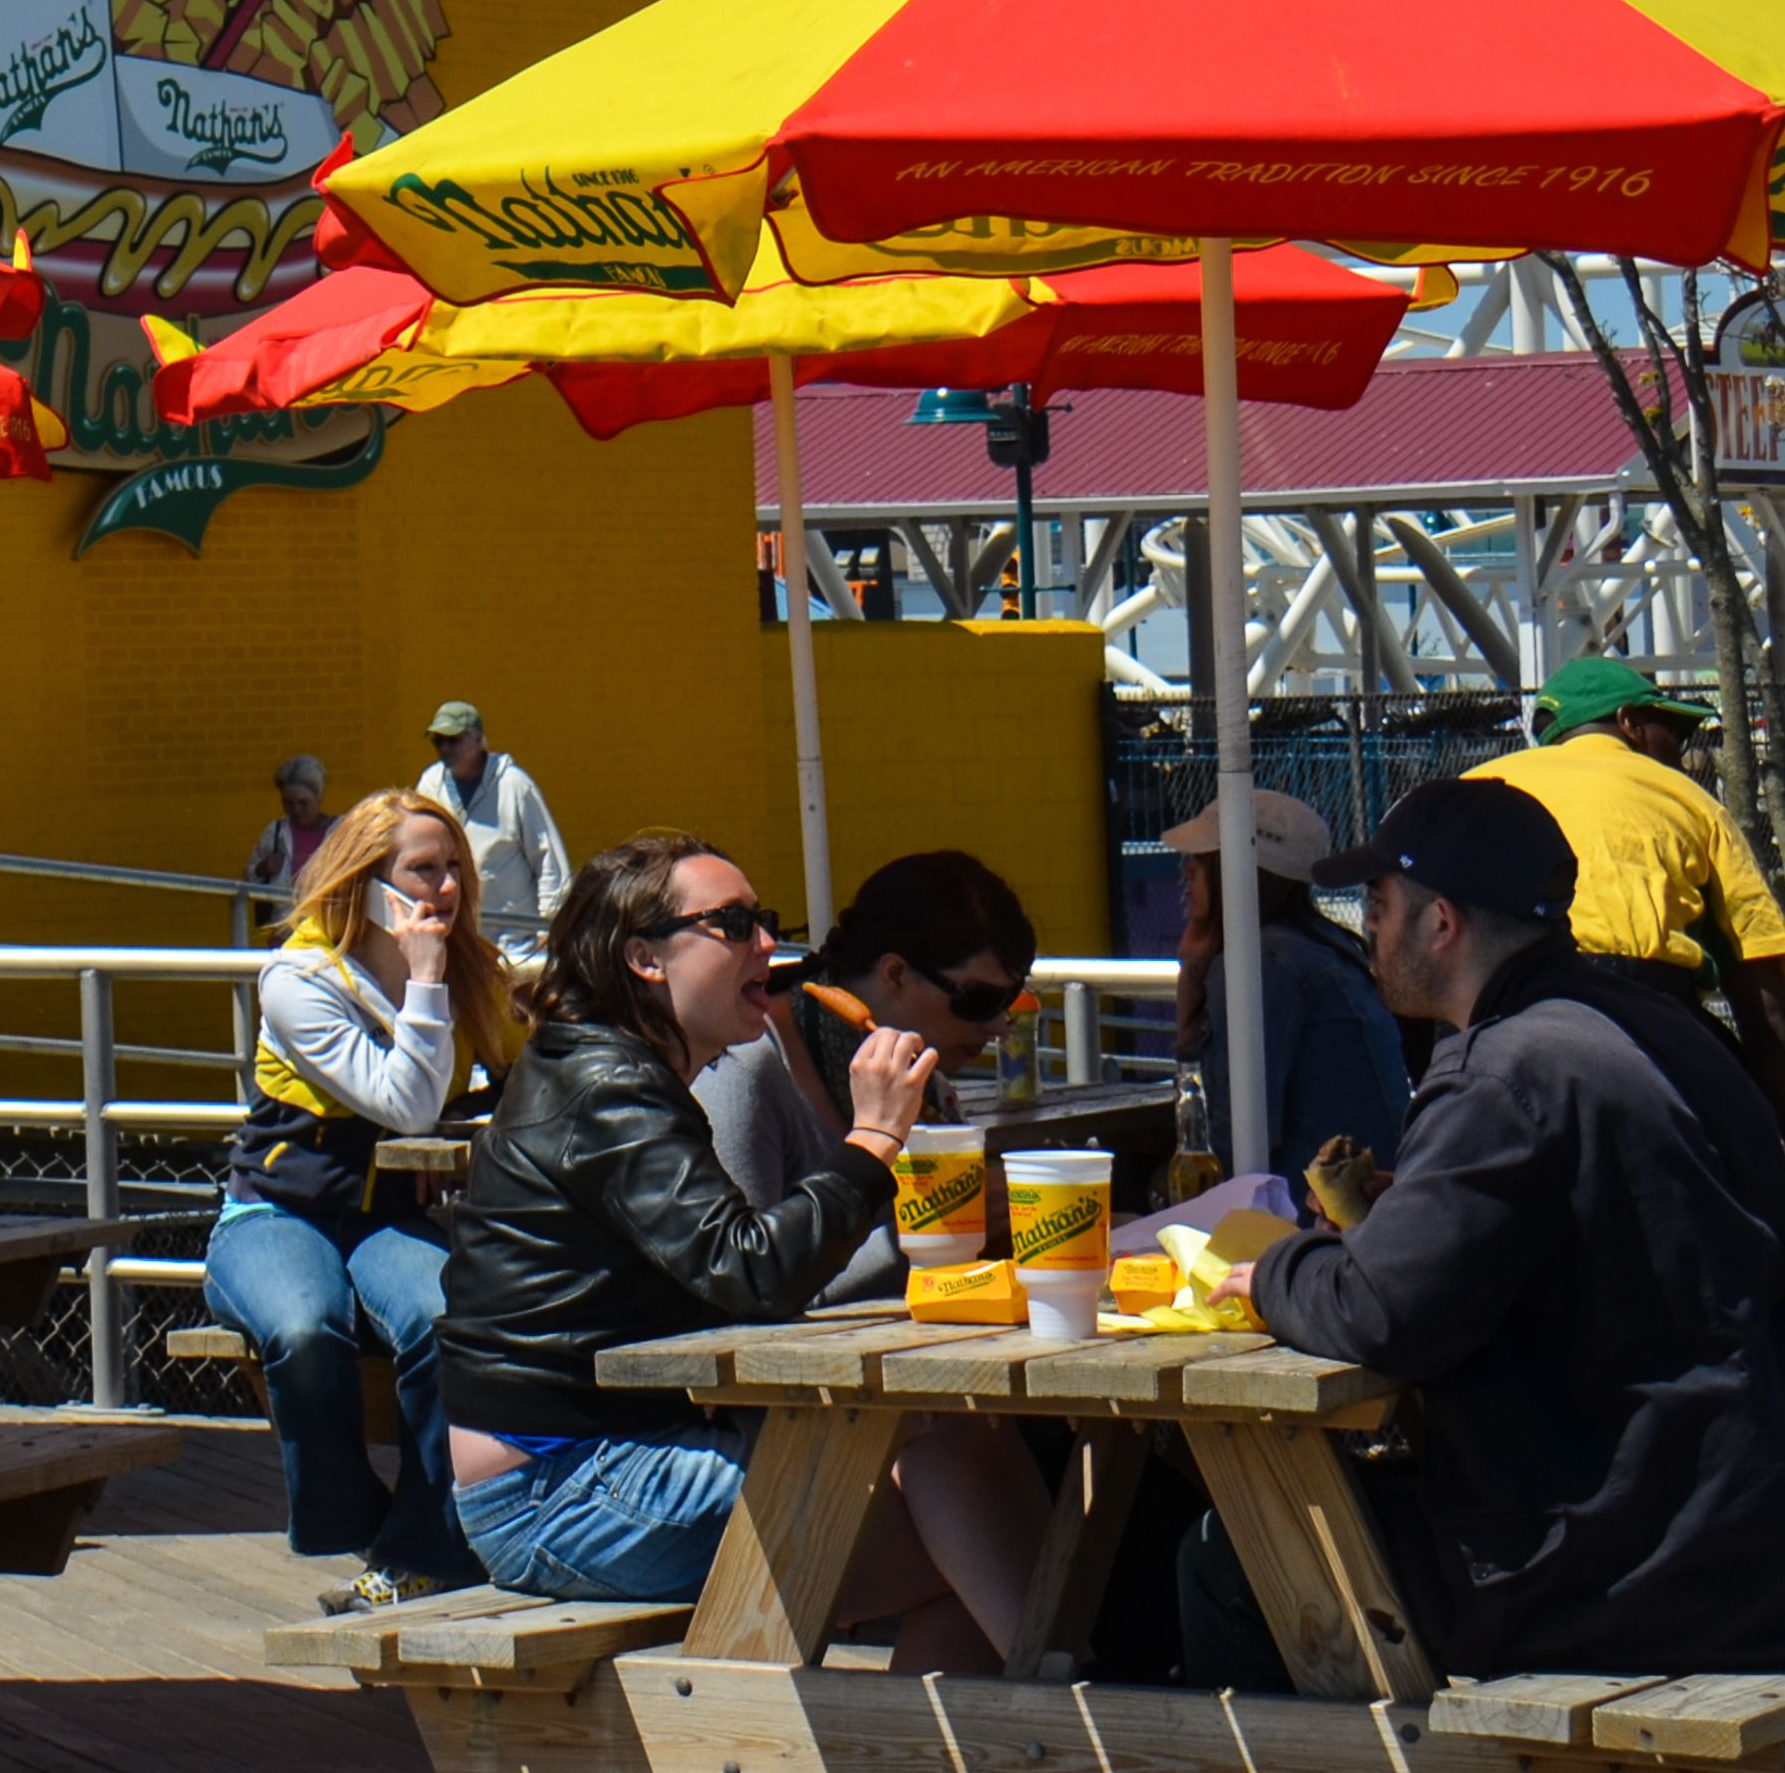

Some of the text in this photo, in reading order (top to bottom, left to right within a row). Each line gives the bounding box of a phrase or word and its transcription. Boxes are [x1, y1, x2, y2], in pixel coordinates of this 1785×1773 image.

[156, 77, 285, 149] Nathan's
[573, 172, 610, 187] SINCE
[896, 158, 1655, 198] AN AMERICAN TRADITION SINCE 1916
[134, 464, 225, 509] FAMOUS
[898, 1162, 985, 1222] Nathan's
